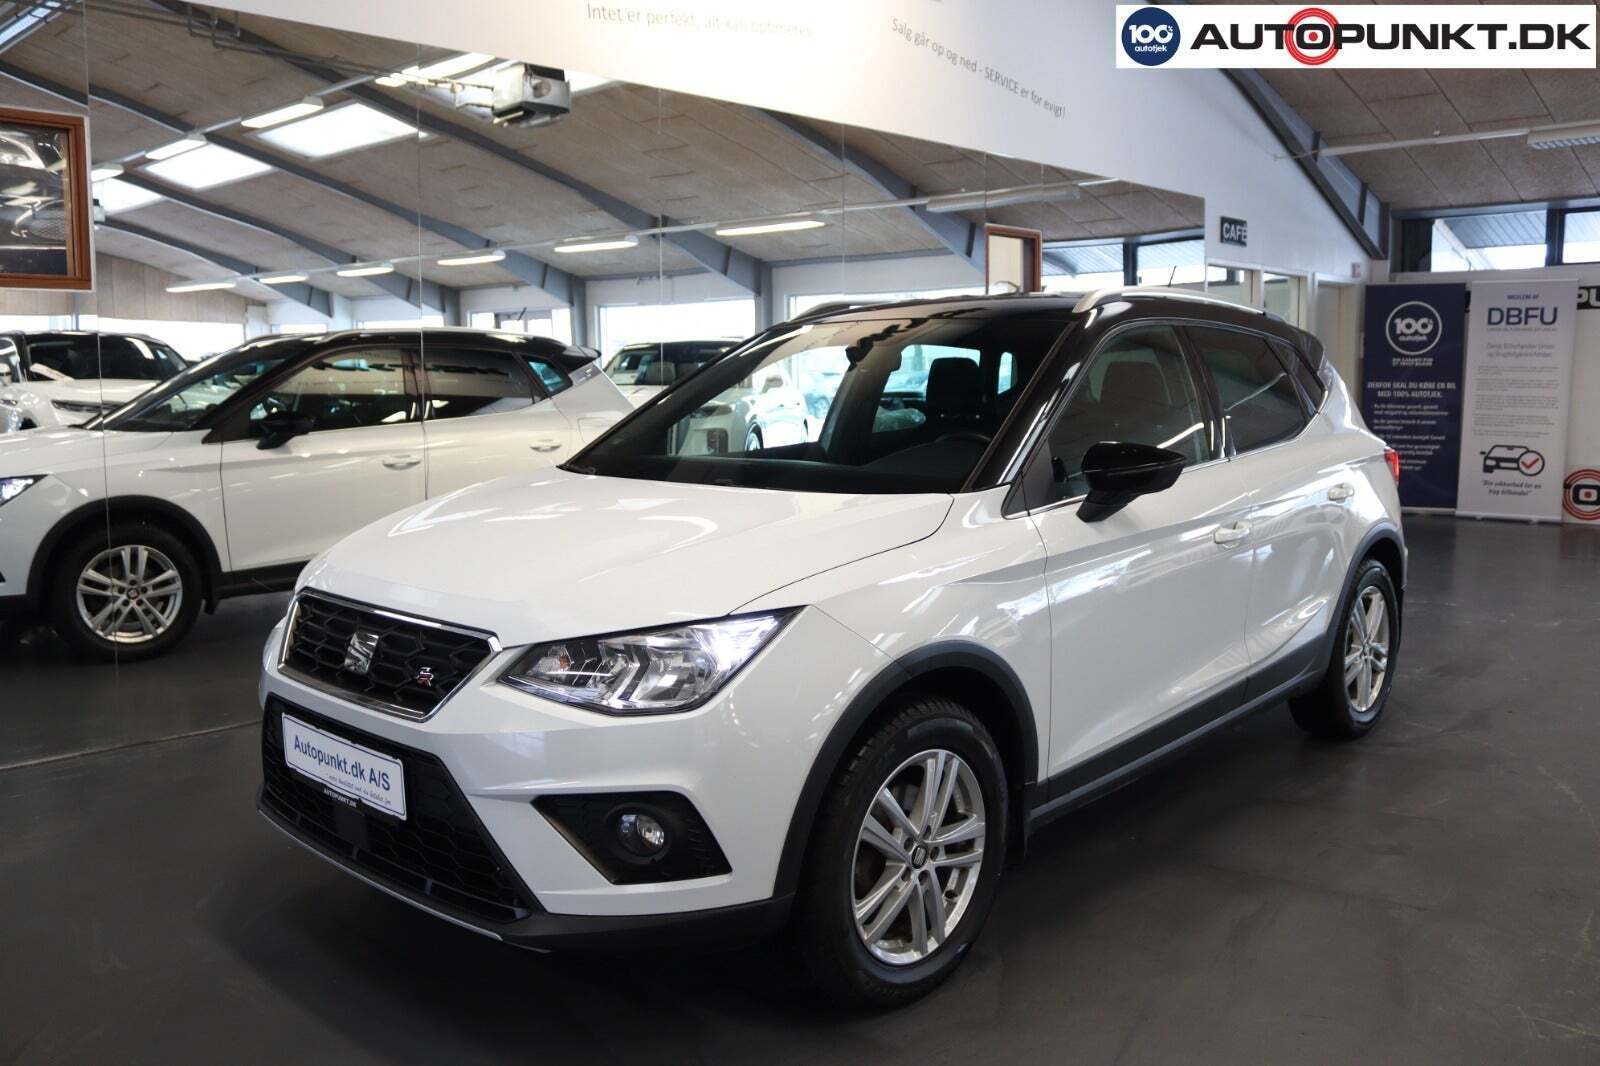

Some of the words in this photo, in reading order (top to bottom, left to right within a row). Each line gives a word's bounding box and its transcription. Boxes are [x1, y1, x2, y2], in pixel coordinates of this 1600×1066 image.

[586, 3, 622, 22] Intet
[627, 9, 642, 23] er
[892, 18, 913, 42] Salg
[914, 32, 930, 49] går
[931, 42, 945, 57] op
[946, 50, 958, 66] og
[959, 57, 977, 73] ned
[984, 67, 1019, 95] SERVICE
[1020, 87, 1028, 98] er
[1487, 306, 1558, 325] DBFU
[293, 735, 366, 782] Autopunkt.dk
[368, 768, 391, 791] A/S
